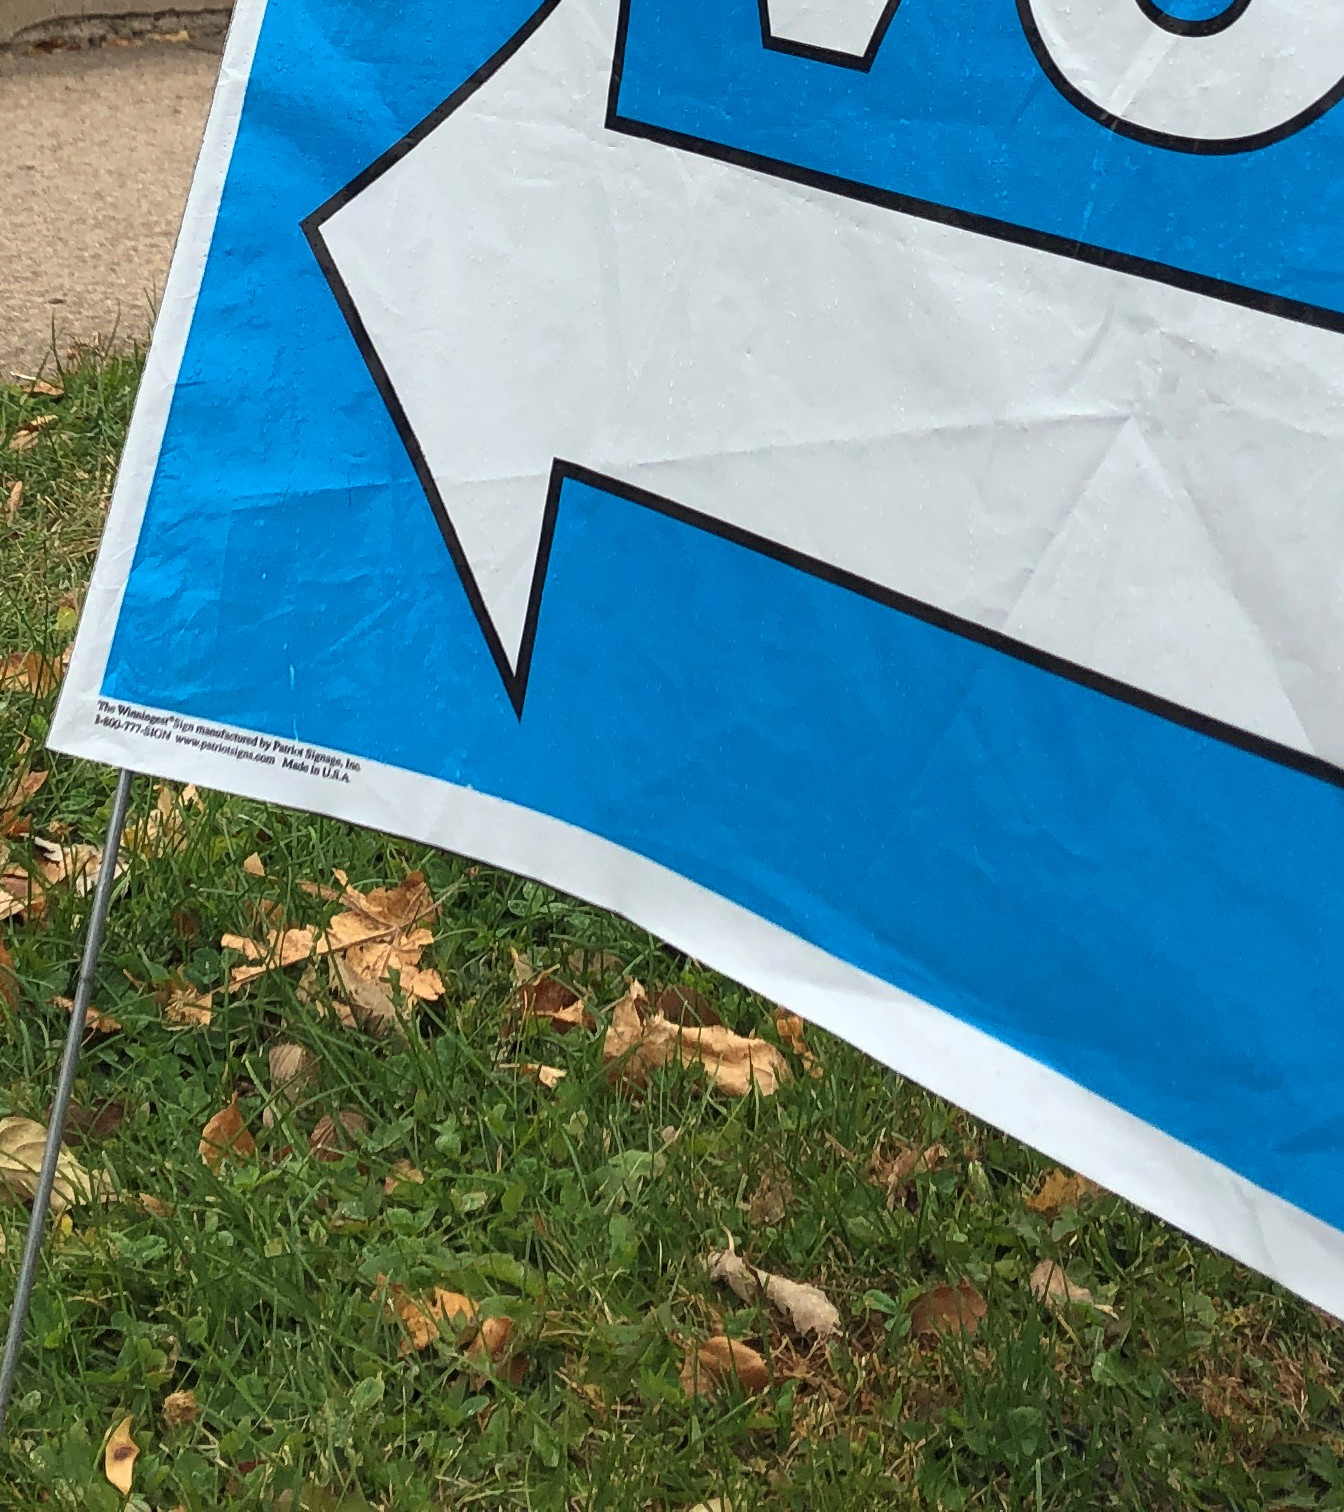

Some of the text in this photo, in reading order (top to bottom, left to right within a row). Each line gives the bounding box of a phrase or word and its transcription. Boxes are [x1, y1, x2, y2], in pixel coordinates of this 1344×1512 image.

[97, 699, 115, 714] The
[173, 717, 194, 732] Sign
[196, 725, 258, 747] manufactured
[259, 737, 271, 751] by
[273, 740, 303, 757] Patriot
[281, 757, 309, 772] Made
[310, 765, 320, 776] in
